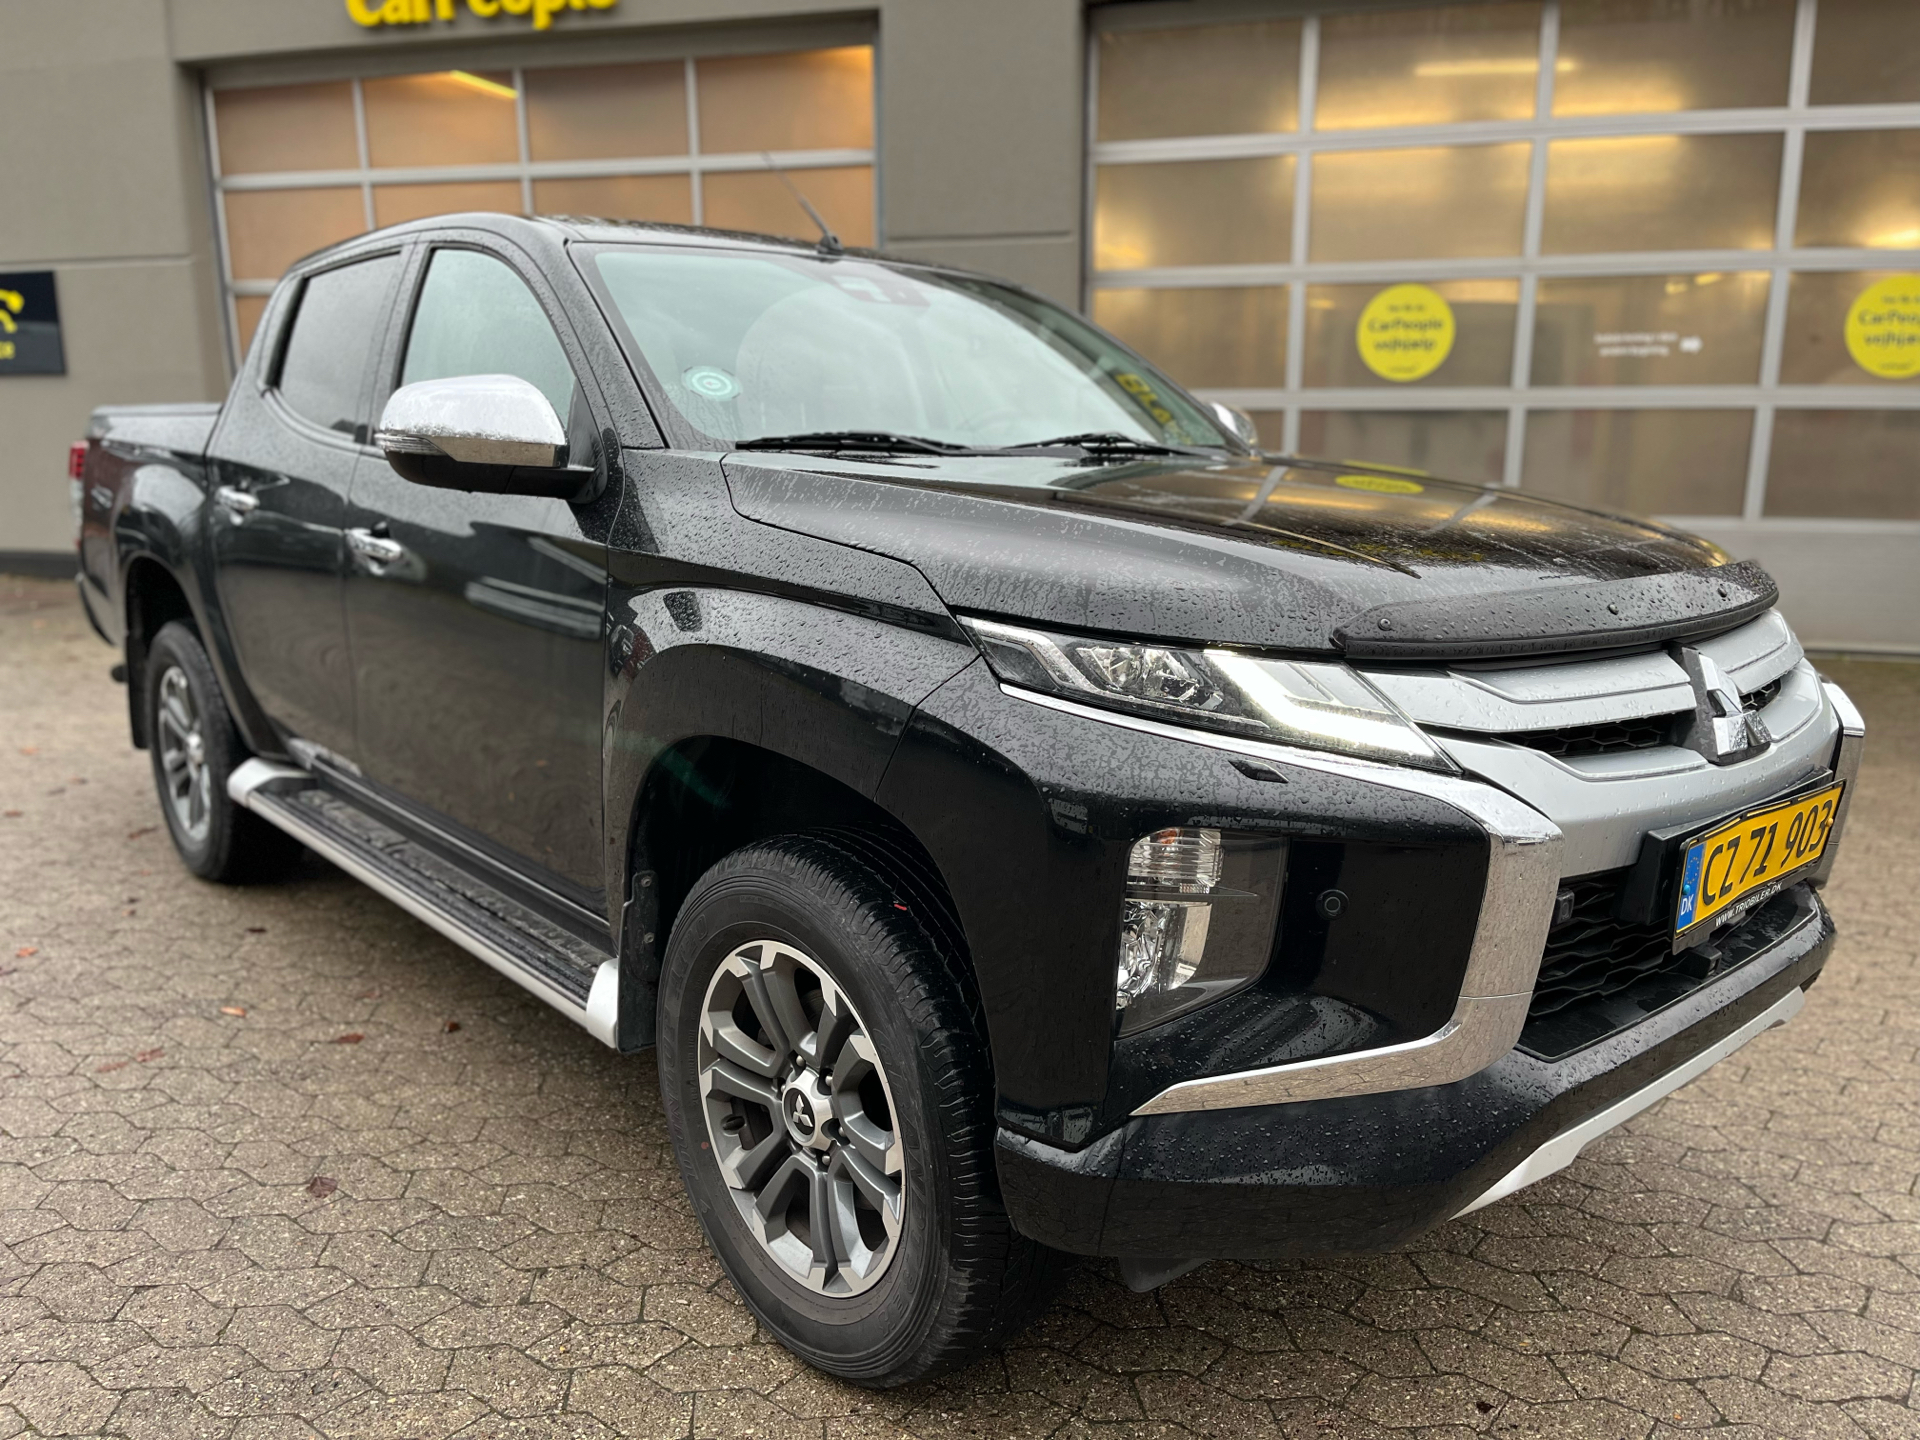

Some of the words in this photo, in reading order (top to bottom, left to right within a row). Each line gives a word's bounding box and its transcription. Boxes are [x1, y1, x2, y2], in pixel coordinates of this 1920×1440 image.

[1703, 834, 1741, 906] CZ
[1739, 822, 1778, 884] 71
[1781, 799, 1833, 868] 903
[1680, 893, 1694, 915] DK
[1716, 883, 1782, 927] WWW.TRIOBILER.DK
[662, 1007, 698, 1182] DUNLOP
